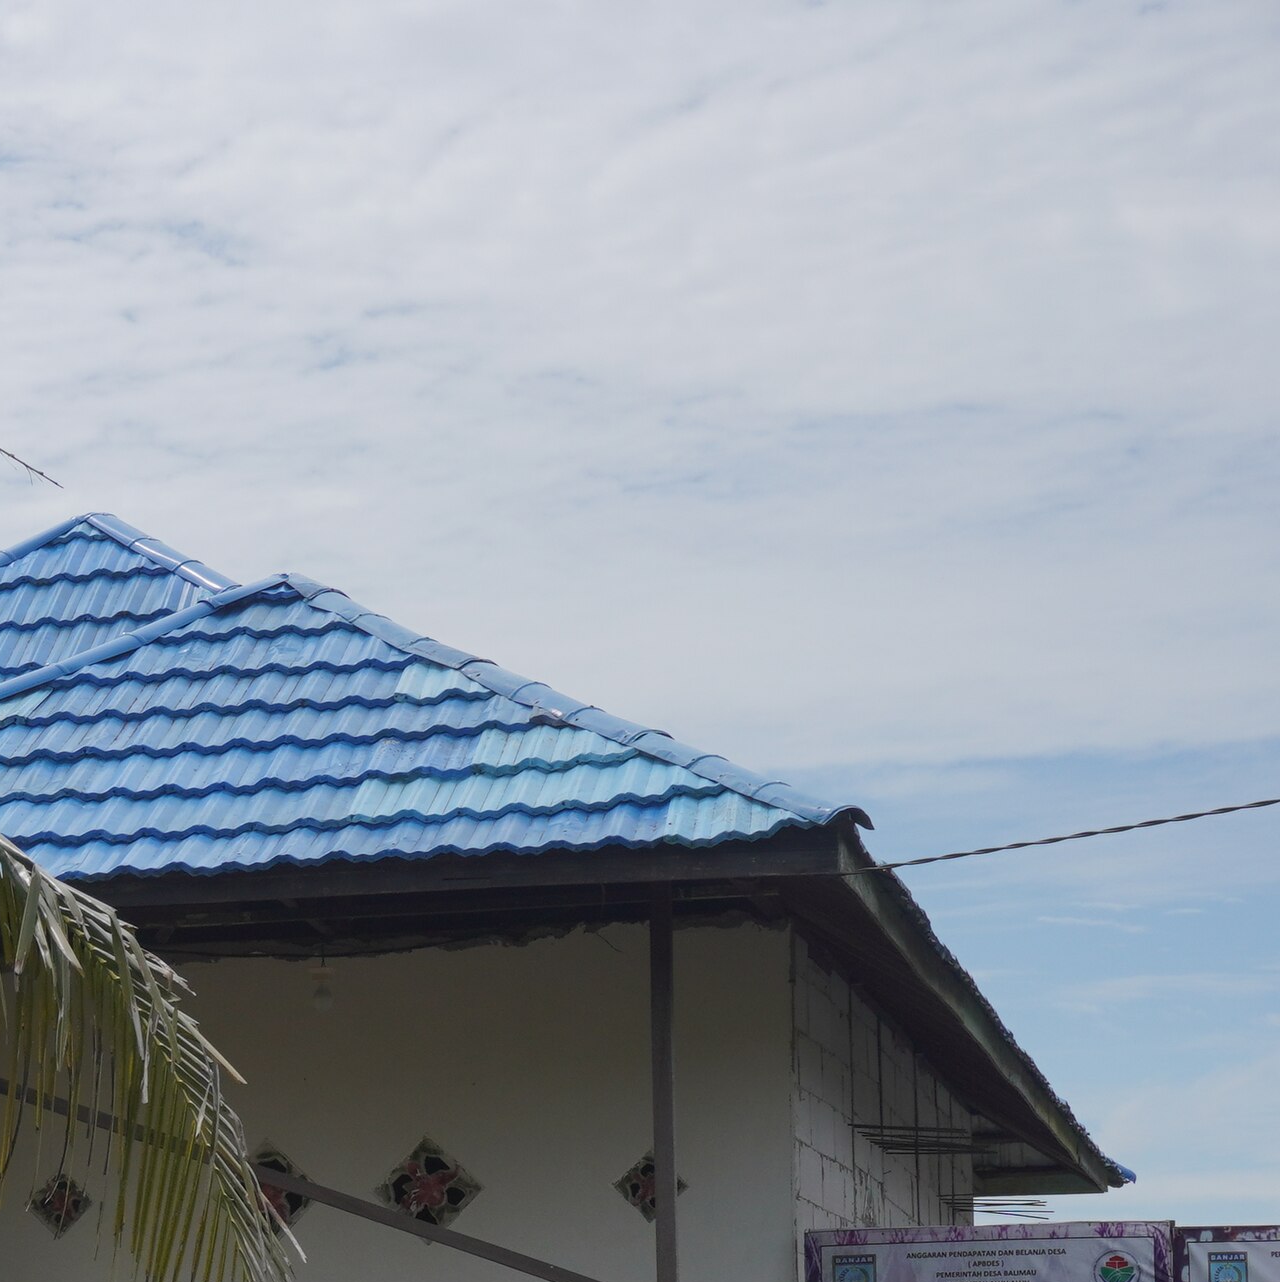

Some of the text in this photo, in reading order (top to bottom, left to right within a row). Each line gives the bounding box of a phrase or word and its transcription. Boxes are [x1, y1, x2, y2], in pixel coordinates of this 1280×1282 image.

[906, 1251, 947, 1260] ANGGARAN
[948, 1250, 996, 1258] PENDAPATAN
[1015, 1249, 1047, 1257] BELANJA
[1048, 1248, 1067, 1256] DESA
[936, 1269, 1037, 1279] PEMERINTAH DESA BALIMAU
